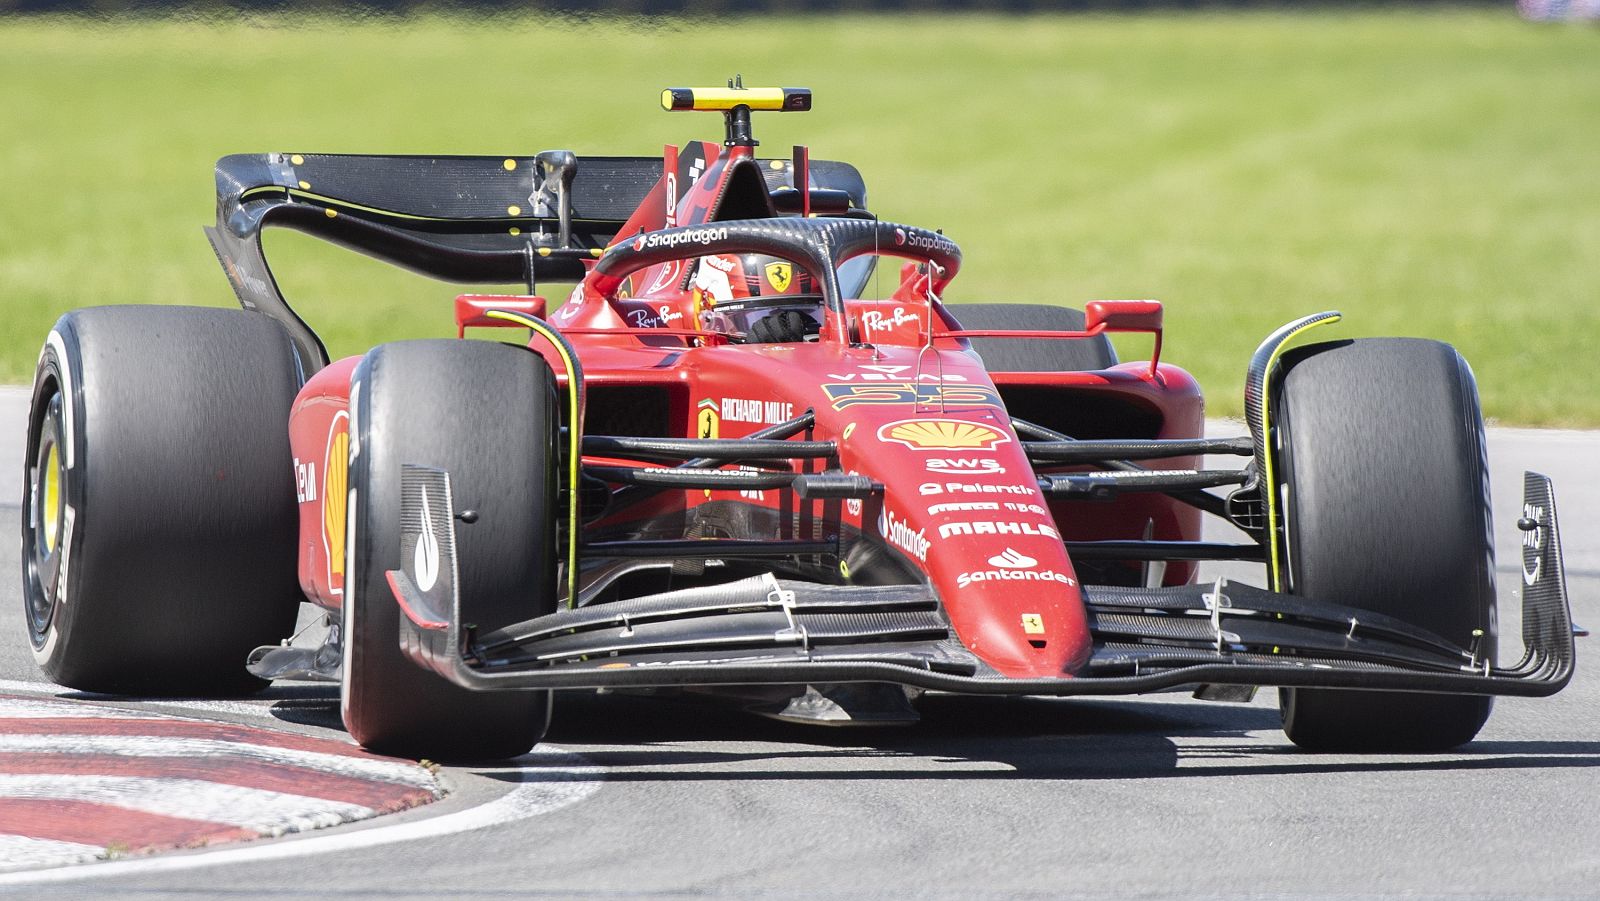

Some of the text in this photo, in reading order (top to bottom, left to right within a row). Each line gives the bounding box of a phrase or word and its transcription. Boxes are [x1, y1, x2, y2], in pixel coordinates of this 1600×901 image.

[647, 228, 728, 248] Snapdragon
[627, 305, 683, 328] Ray-Ban
[862, 307, 919, 332] Ray-Ban
[821, 383, 1008, 411] 55
[721, 398, 793, 424] RICHARD MILLE
[925, 458, 1003, 470] aws
[946, 482, 1036, 496] Palantir
[888, 511, 931, 562] Santander
[938, 521, 1059, 540] MAHLE
[956, 568, 1075, 589] Santander
